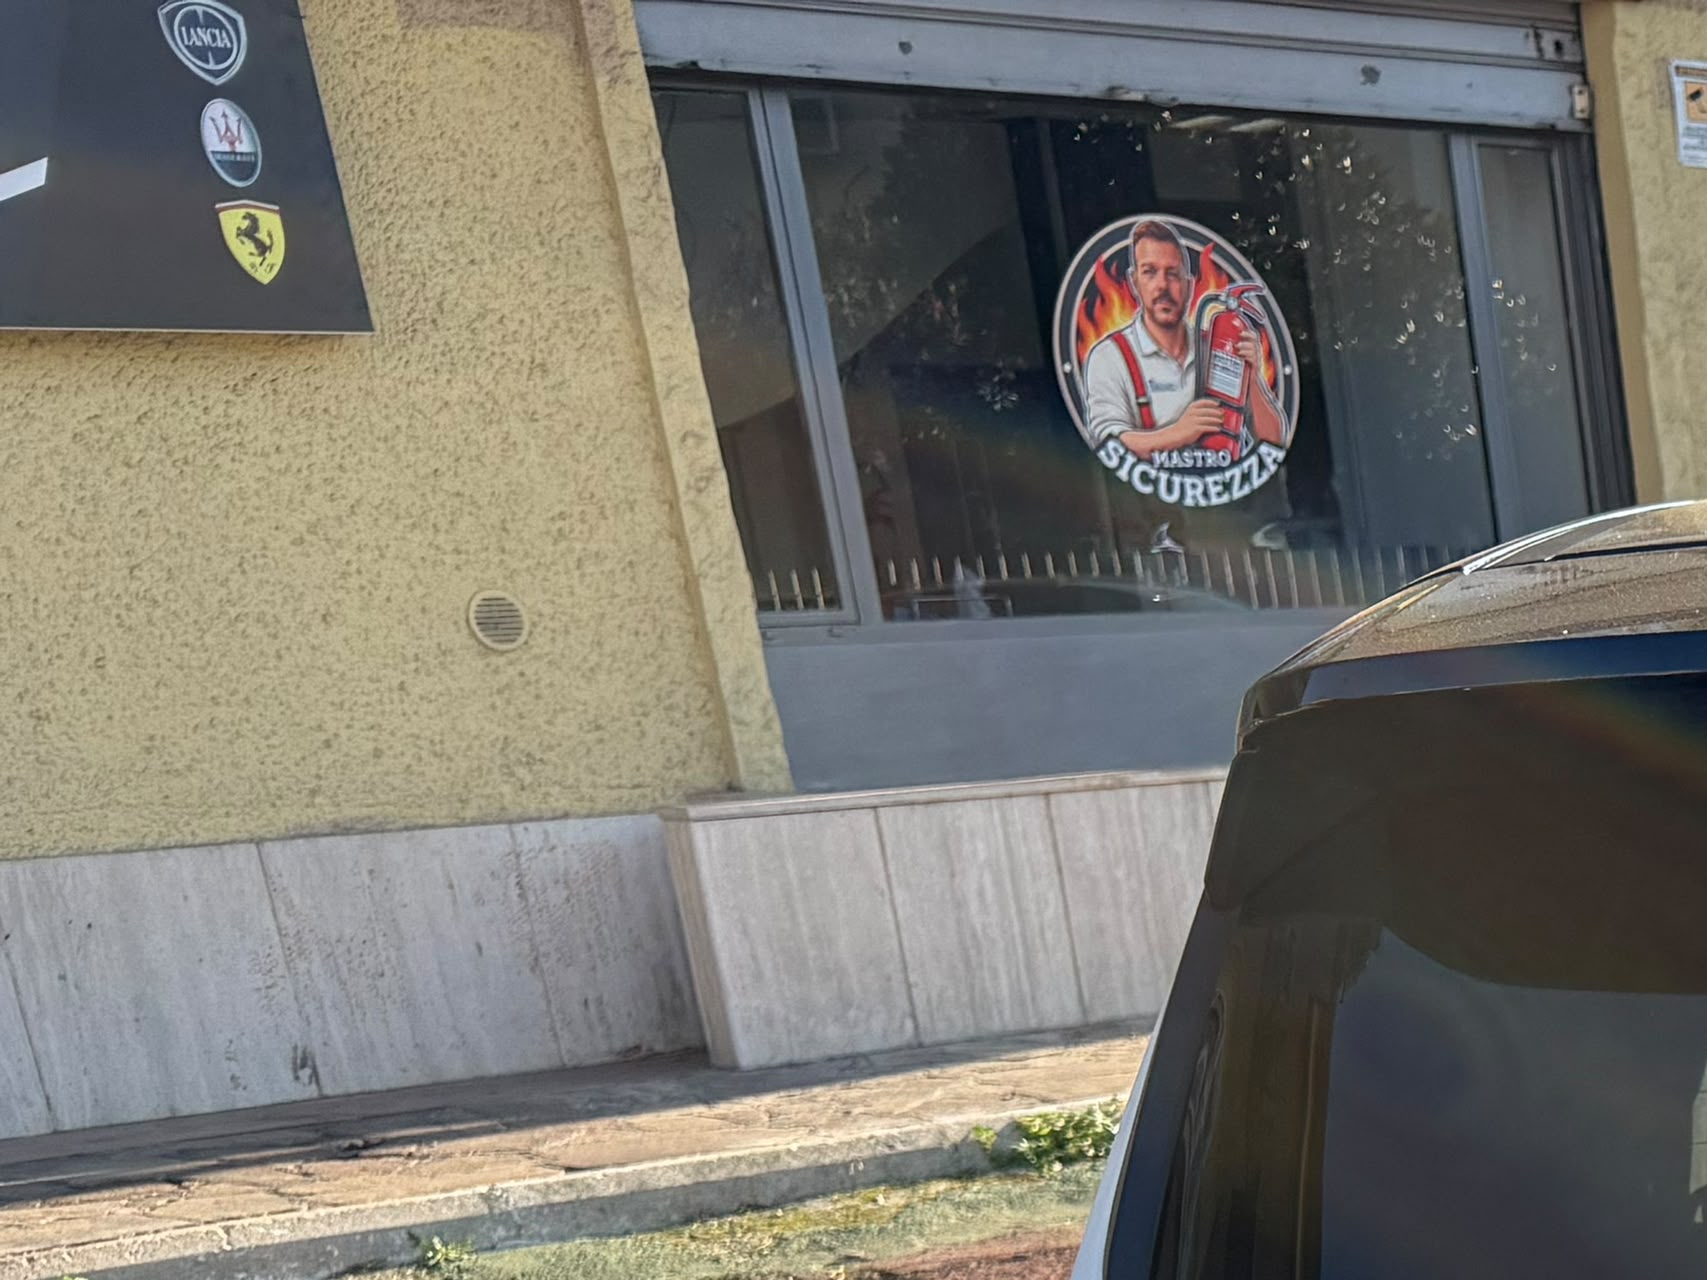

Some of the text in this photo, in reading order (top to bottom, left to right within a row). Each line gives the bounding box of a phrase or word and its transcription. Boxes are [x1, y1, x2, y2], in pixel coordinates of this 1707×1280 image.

[181, 26, 232, 48] LANCIA
[1150, 448, 1232, 469] MASTRO
[1097, 438, 1287, 507] SICUREZZA
